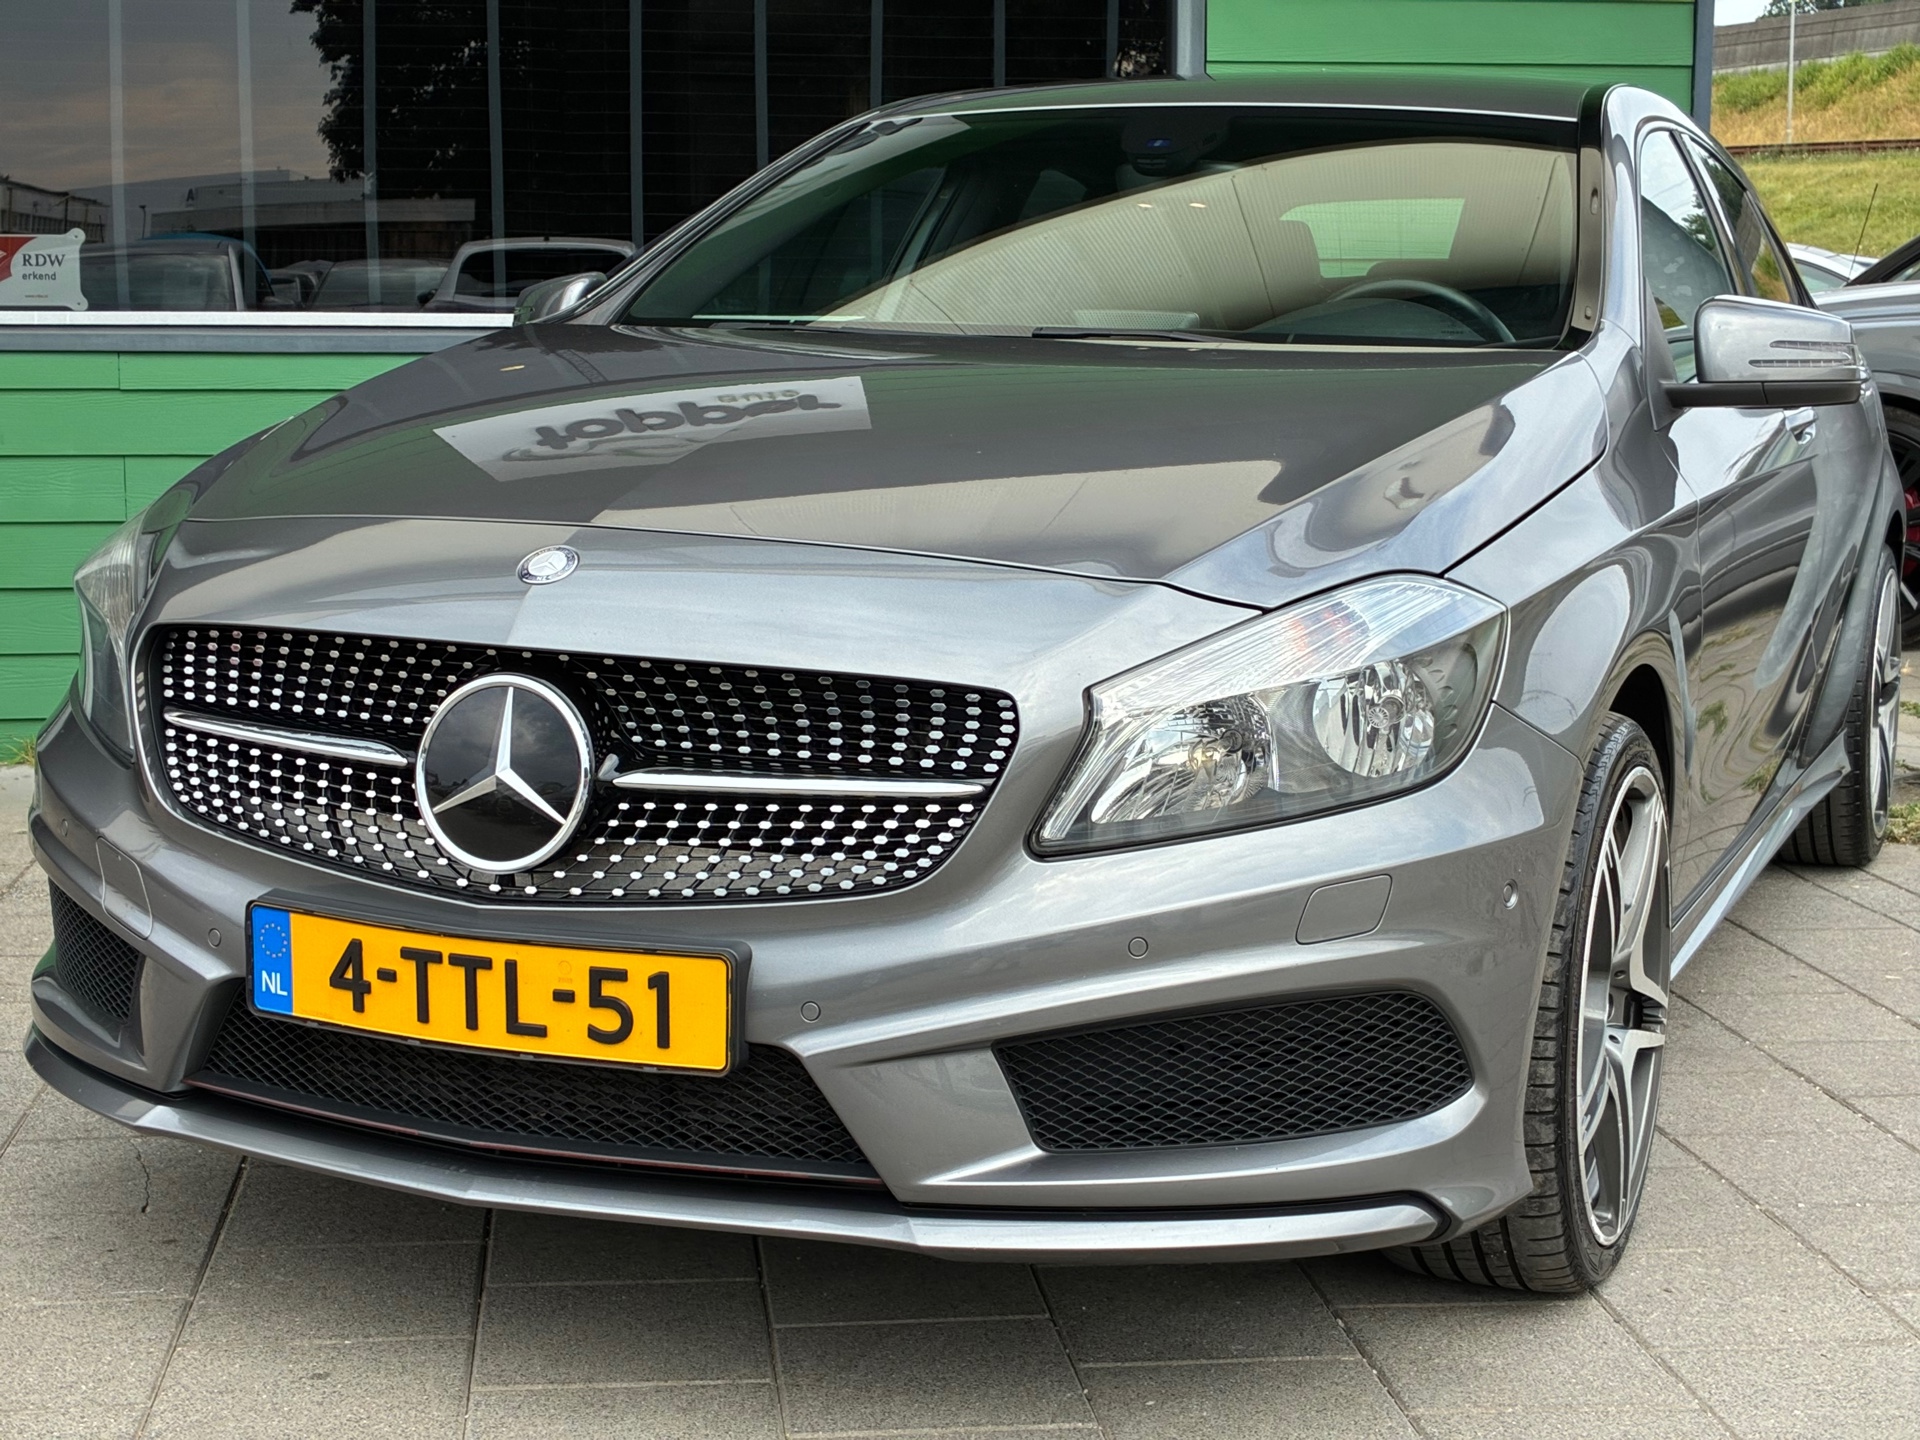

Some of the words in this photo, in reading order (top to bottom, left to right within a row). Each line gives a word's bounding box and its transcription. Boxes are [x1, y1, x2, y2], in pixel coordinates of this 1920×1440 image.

[22, 253, 66, 267] RDW
[22, 271, 57, 281] erkend
[261, 969, 288, 996] NL
[329, 938, 670, 1049] 4-TTL-51
